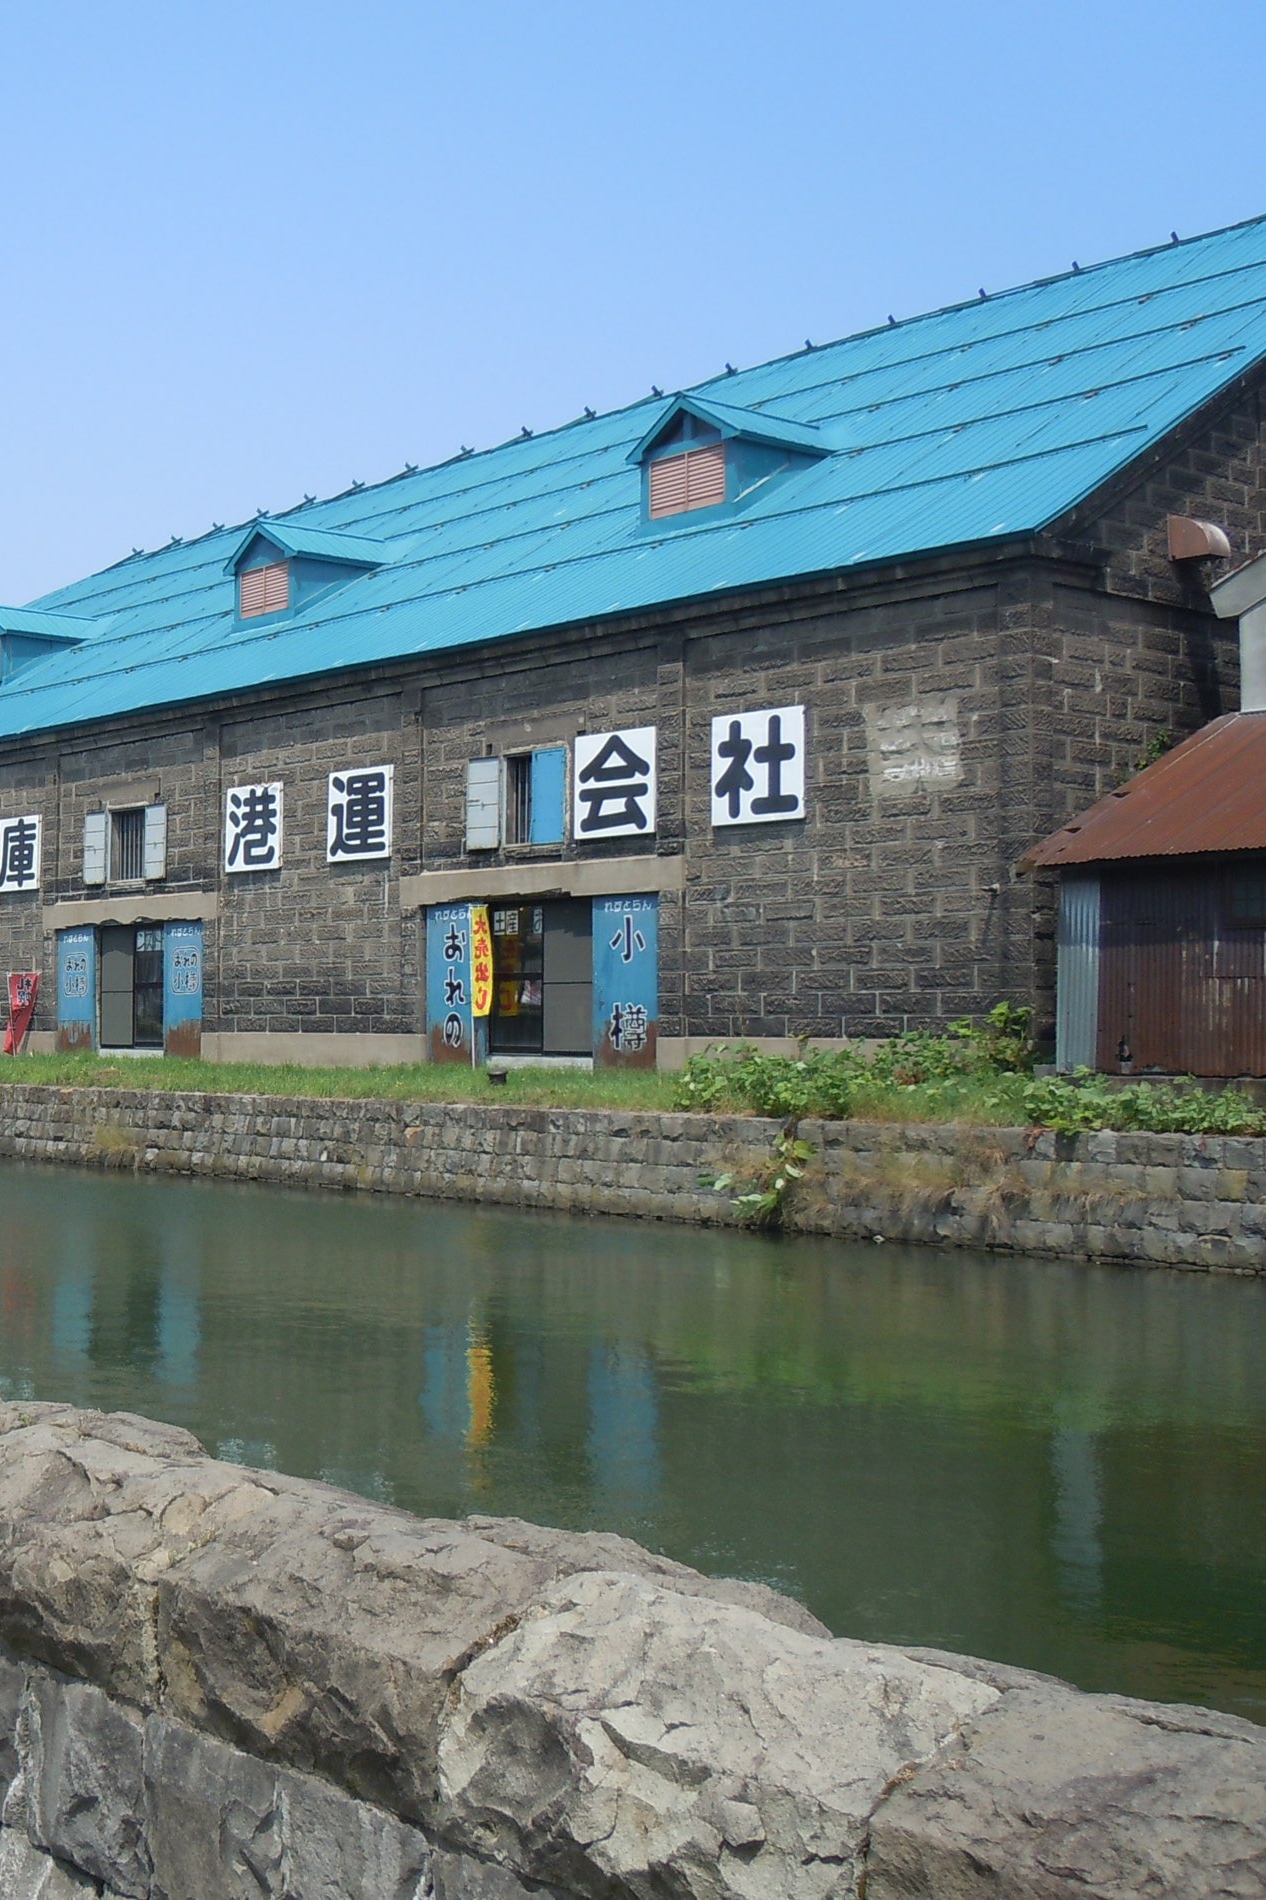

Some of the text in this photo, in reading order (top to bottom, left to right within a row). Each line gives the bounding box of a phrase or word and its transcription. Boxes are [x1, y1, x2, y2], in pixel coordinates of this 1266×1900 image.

[443, 922, 467, 1048] おれの
[609, 914, 648, 1051] 小樽
